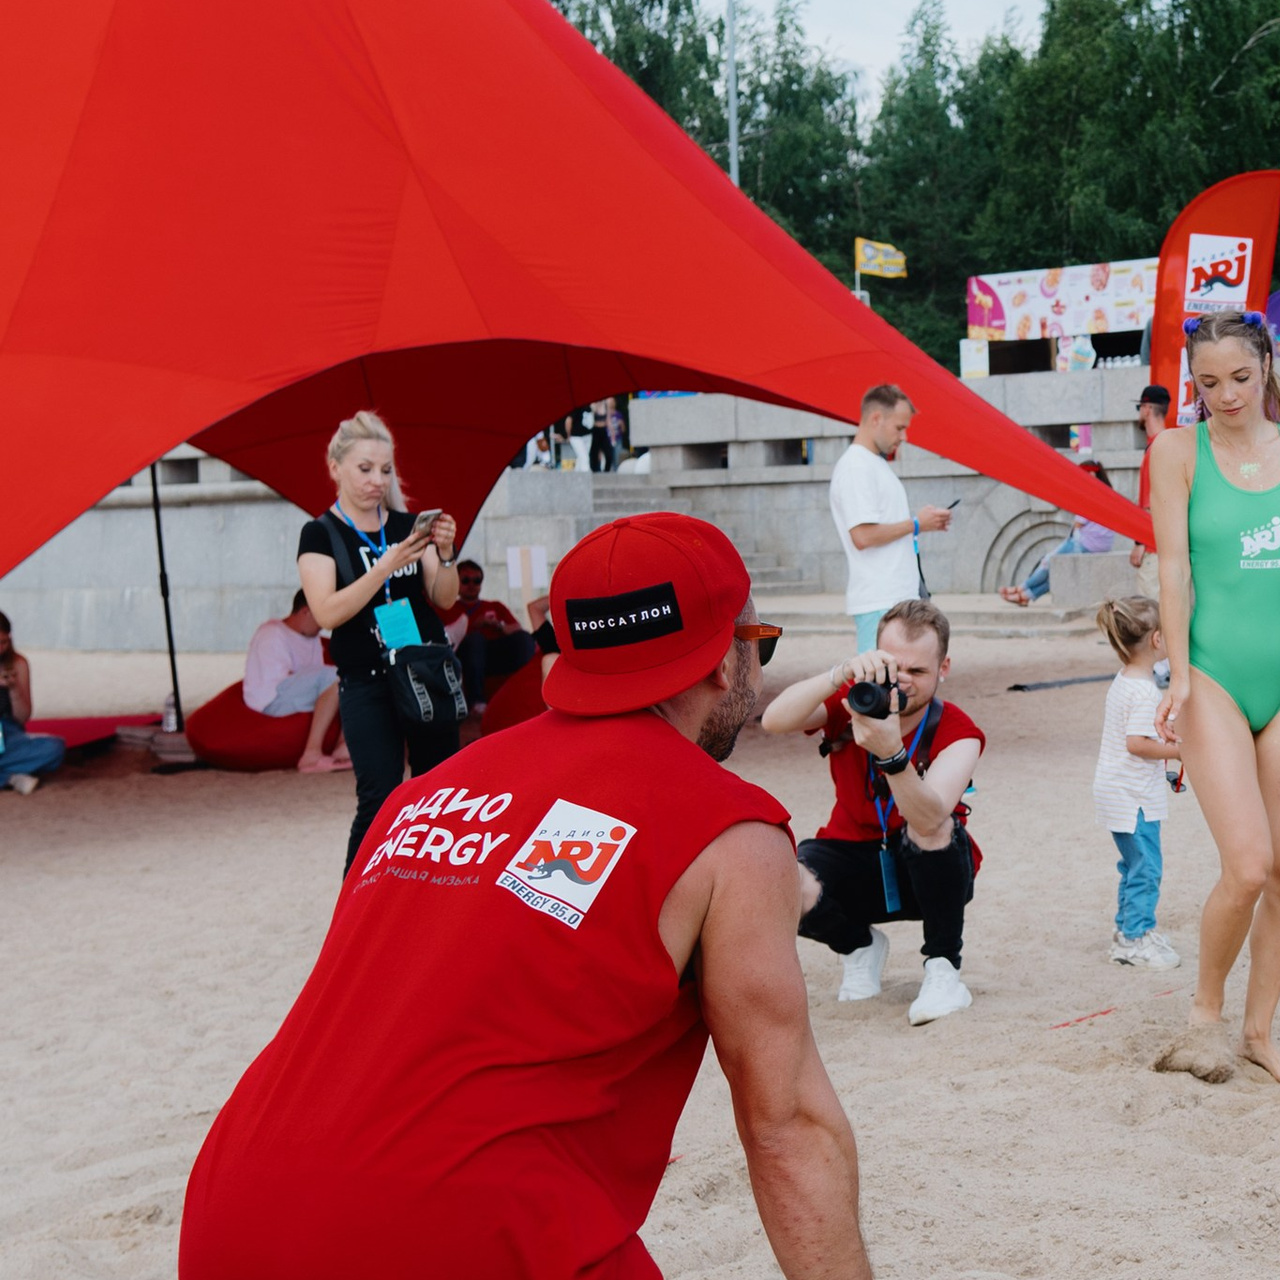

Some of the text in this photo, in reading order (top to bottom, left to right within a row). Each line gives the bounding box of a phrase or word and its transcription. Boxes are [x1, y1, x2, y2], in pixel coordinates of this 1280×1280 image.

[574, 604, 672, 632] КРОССАТЛОН
[386, 787, 513, 836] РАДИО
[538, 829, 605, 839] РАДИО
[361, 824, 511, 876] ENERGY
[515, 825, 627, 885] NRJ
[430, 875, 480, 886] МУЗЫКА
[499, 874, 580, 926] ENERGY 95.0
